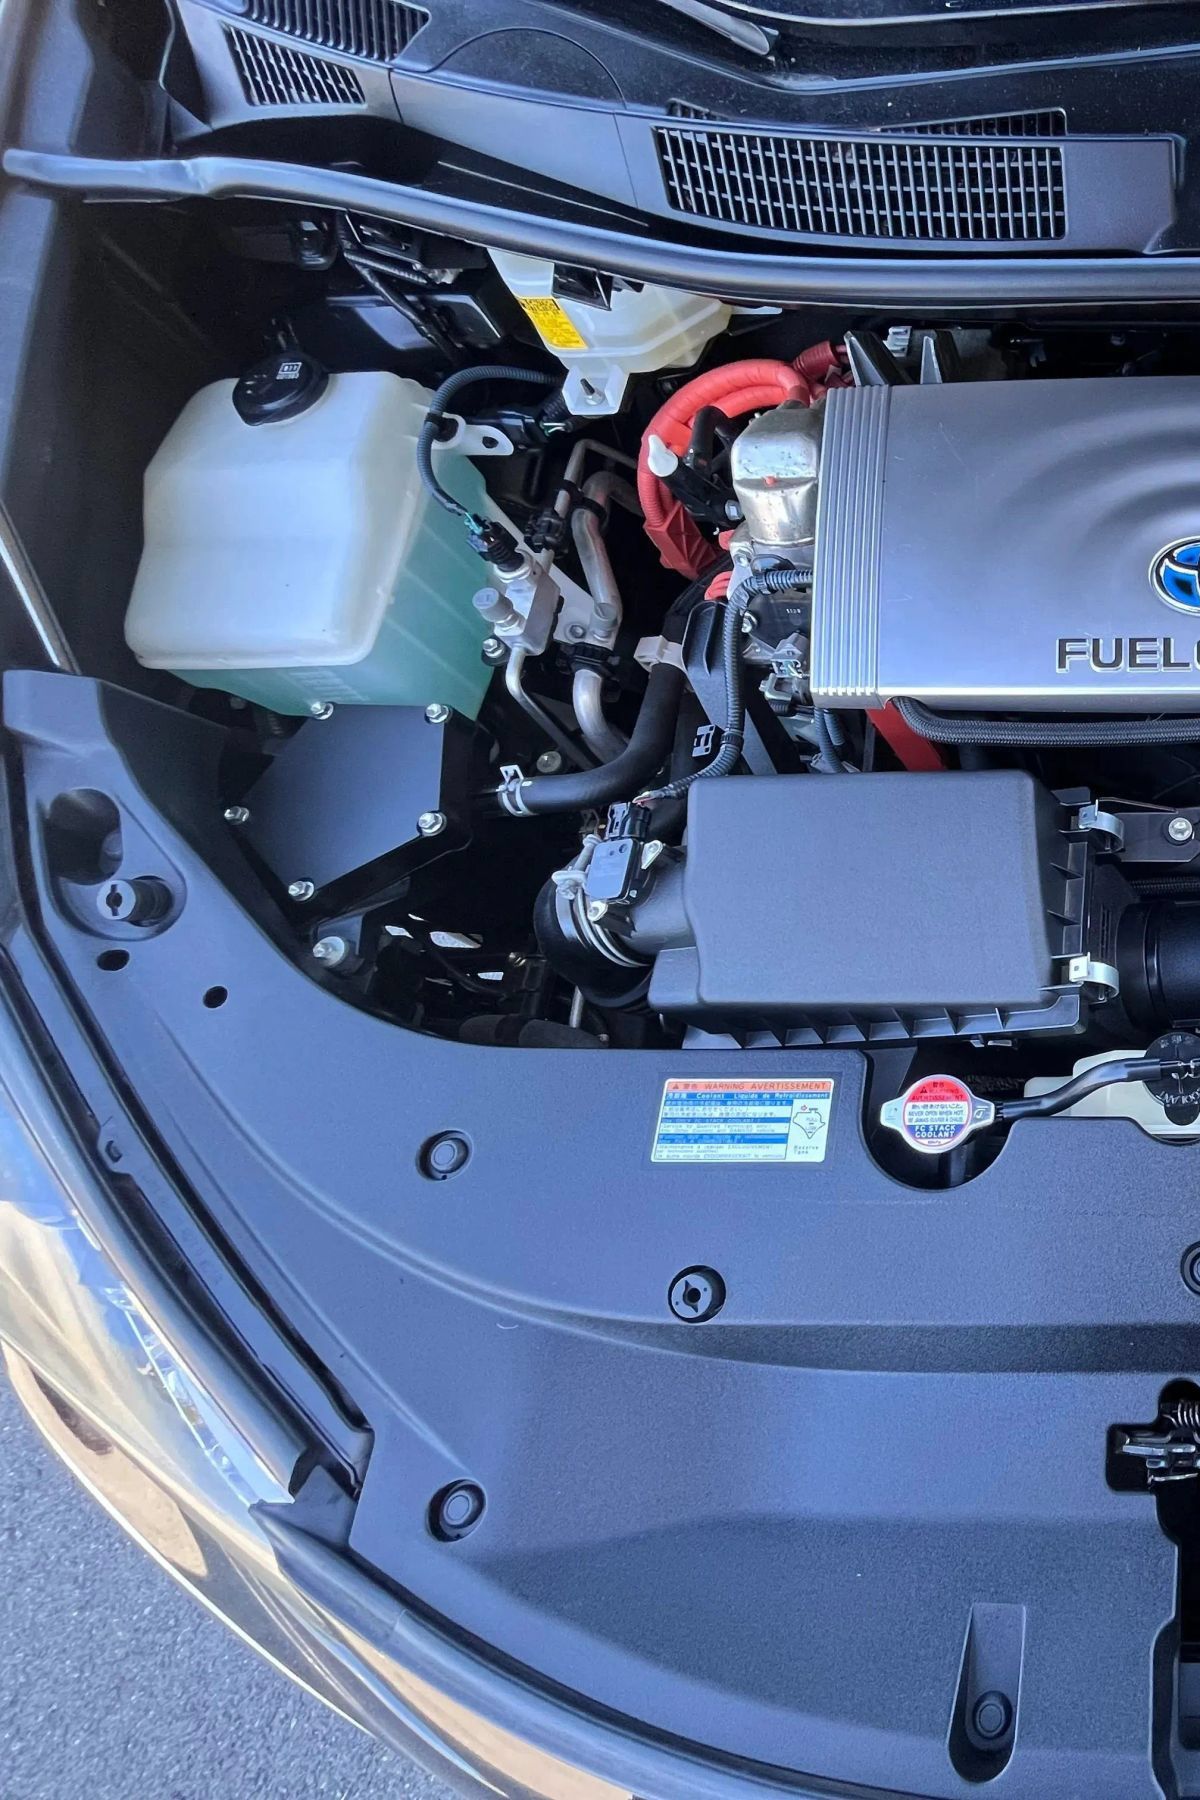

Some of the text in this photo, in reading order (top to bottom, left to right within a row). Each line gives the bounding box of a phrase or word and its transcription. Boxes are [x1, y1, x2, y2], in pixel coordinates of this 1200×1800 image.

[704, 1082, 745, 1090] WARNING
[751, 1082, 827, 1090] AVERTISSEMENT
[929, 1124, 956, 1132] STACK
